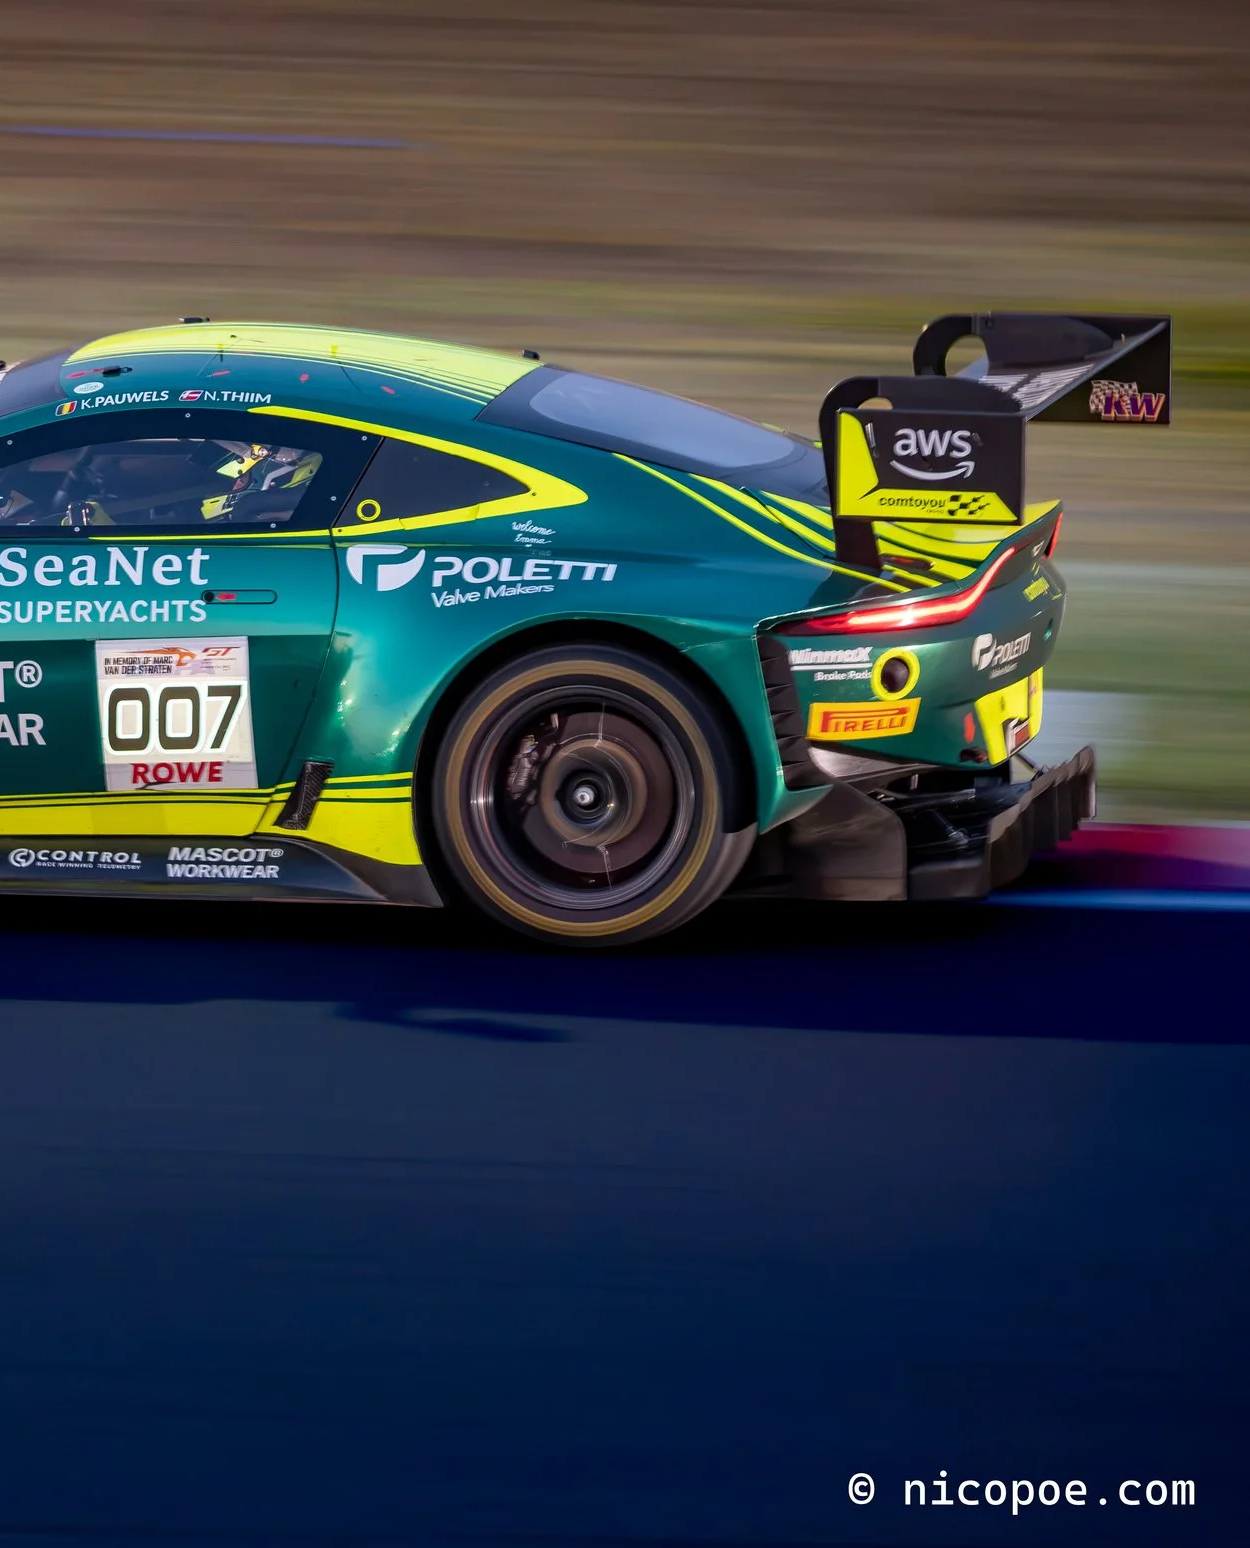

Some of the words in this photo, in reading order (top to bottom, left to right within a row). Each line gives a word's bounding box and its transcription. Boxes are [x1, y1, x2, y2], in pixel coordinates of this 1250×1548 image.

[80, 390, 169, 410] K.PAUWELS
[204, 390, 272, 404] N.THIIM
[893, 427, 972, 458] aws
[878, 496, 946, 510] comtoyou
[432, 556, 618, 587] POLETTI
[431, 588, 481, 608] Valve
[484, 583, 555, 600] Makers
[107, 684, 243, 752] 007
[820, 707, 910, 733] PIRELLI
[130, 761, 223, 784] ROWE
[166, 863, 280, 878] WORKWEAR
